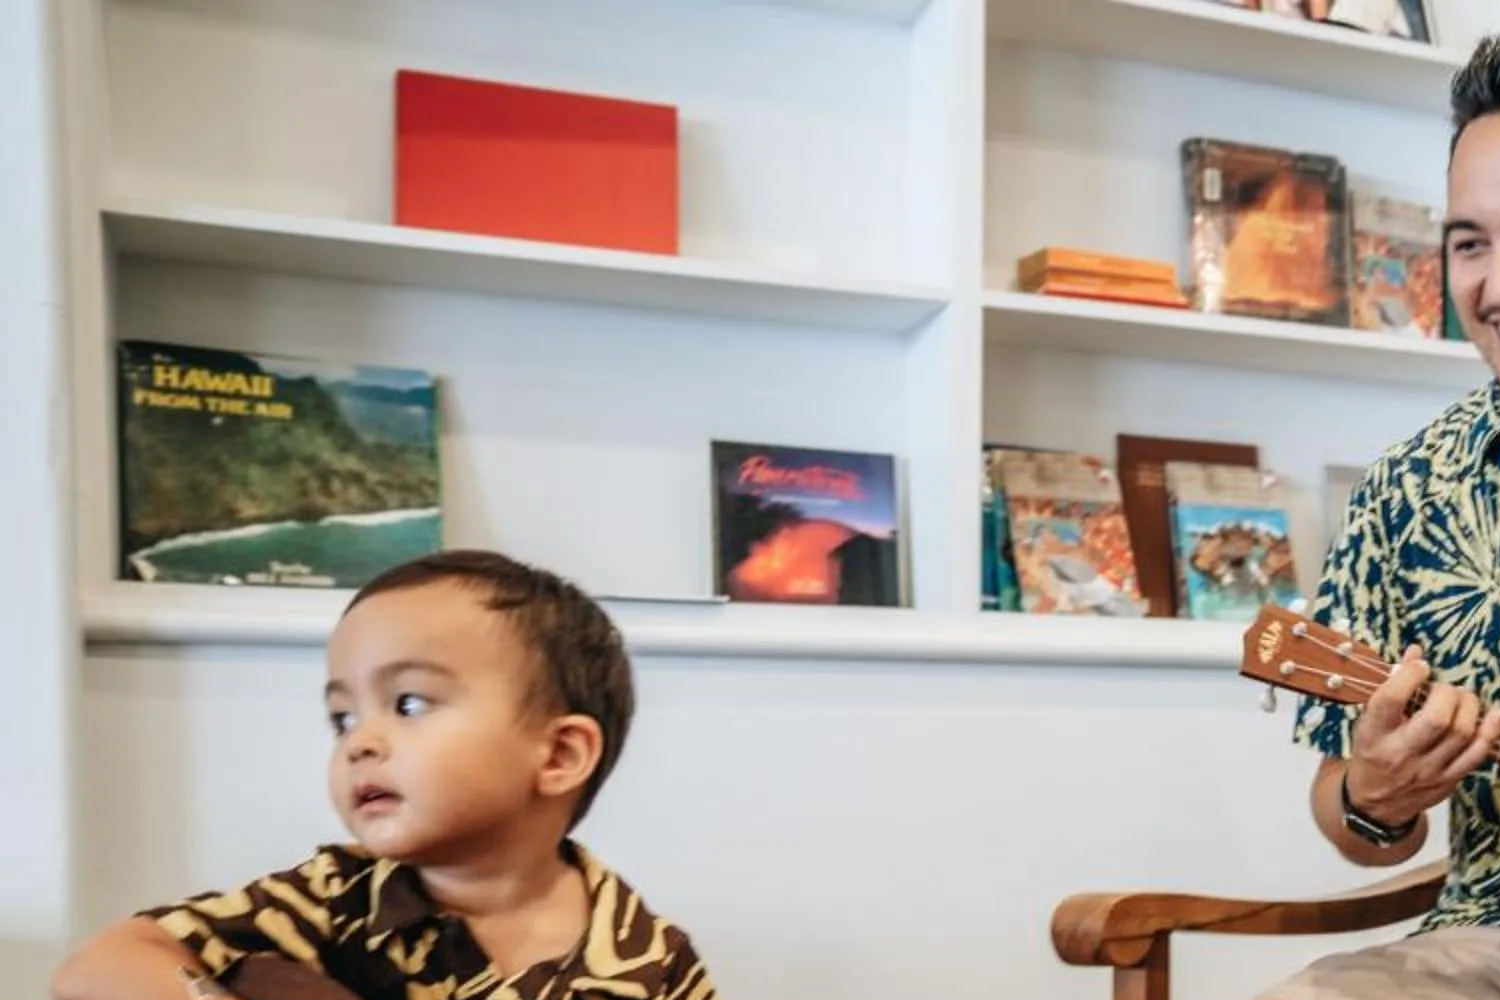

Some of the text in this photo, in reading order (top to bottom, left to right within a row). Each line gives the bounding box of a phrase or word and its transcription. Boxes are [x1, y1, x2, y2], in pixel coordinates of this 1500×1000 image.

[154, 365, 272, 396] HAWAII
[134, 390, 293, 419] FROM THE AIR
